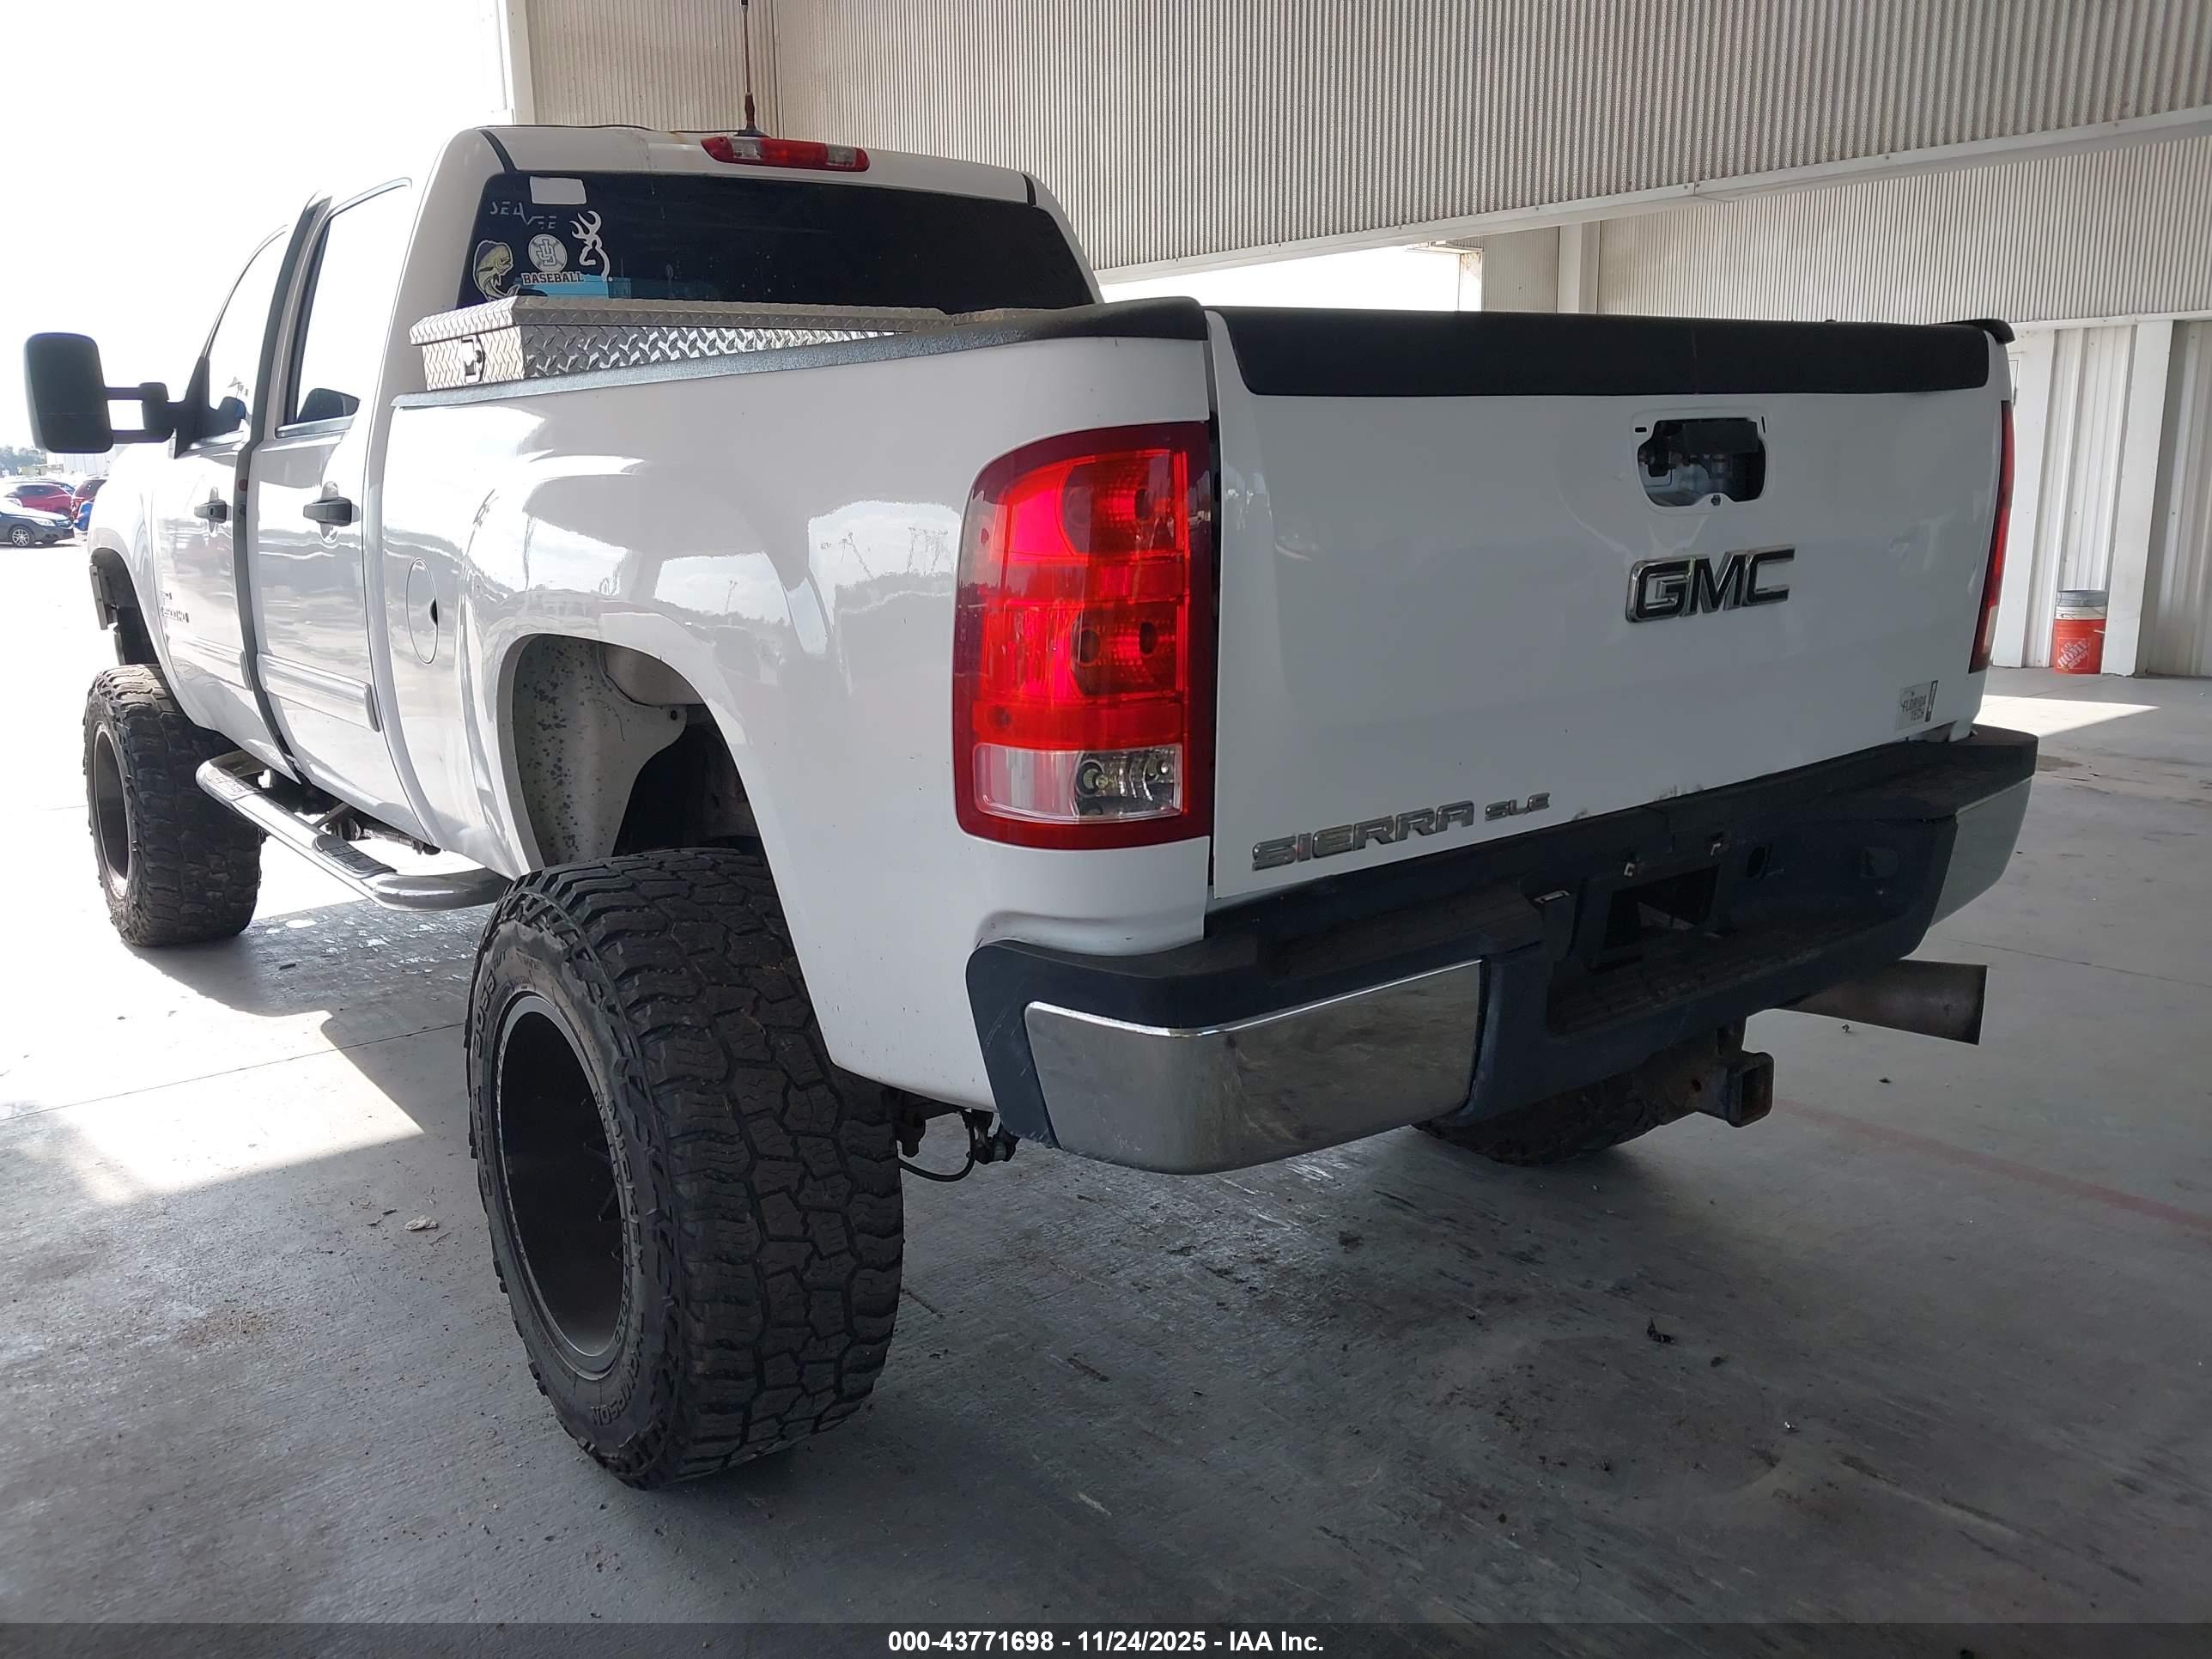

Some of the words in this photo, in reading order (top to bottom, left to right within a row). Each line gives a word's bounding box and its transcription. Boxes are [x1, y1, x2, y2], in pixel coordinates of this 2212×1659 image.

[521, 270, 585, 285] BASEBALL
[1625, 544, 1796, 623] GMC
[2057, 641, 2088, 667] HOME
[1251, 799, 1474, 872] SIERRA
[1485, 792, 1551, 822] SLE
